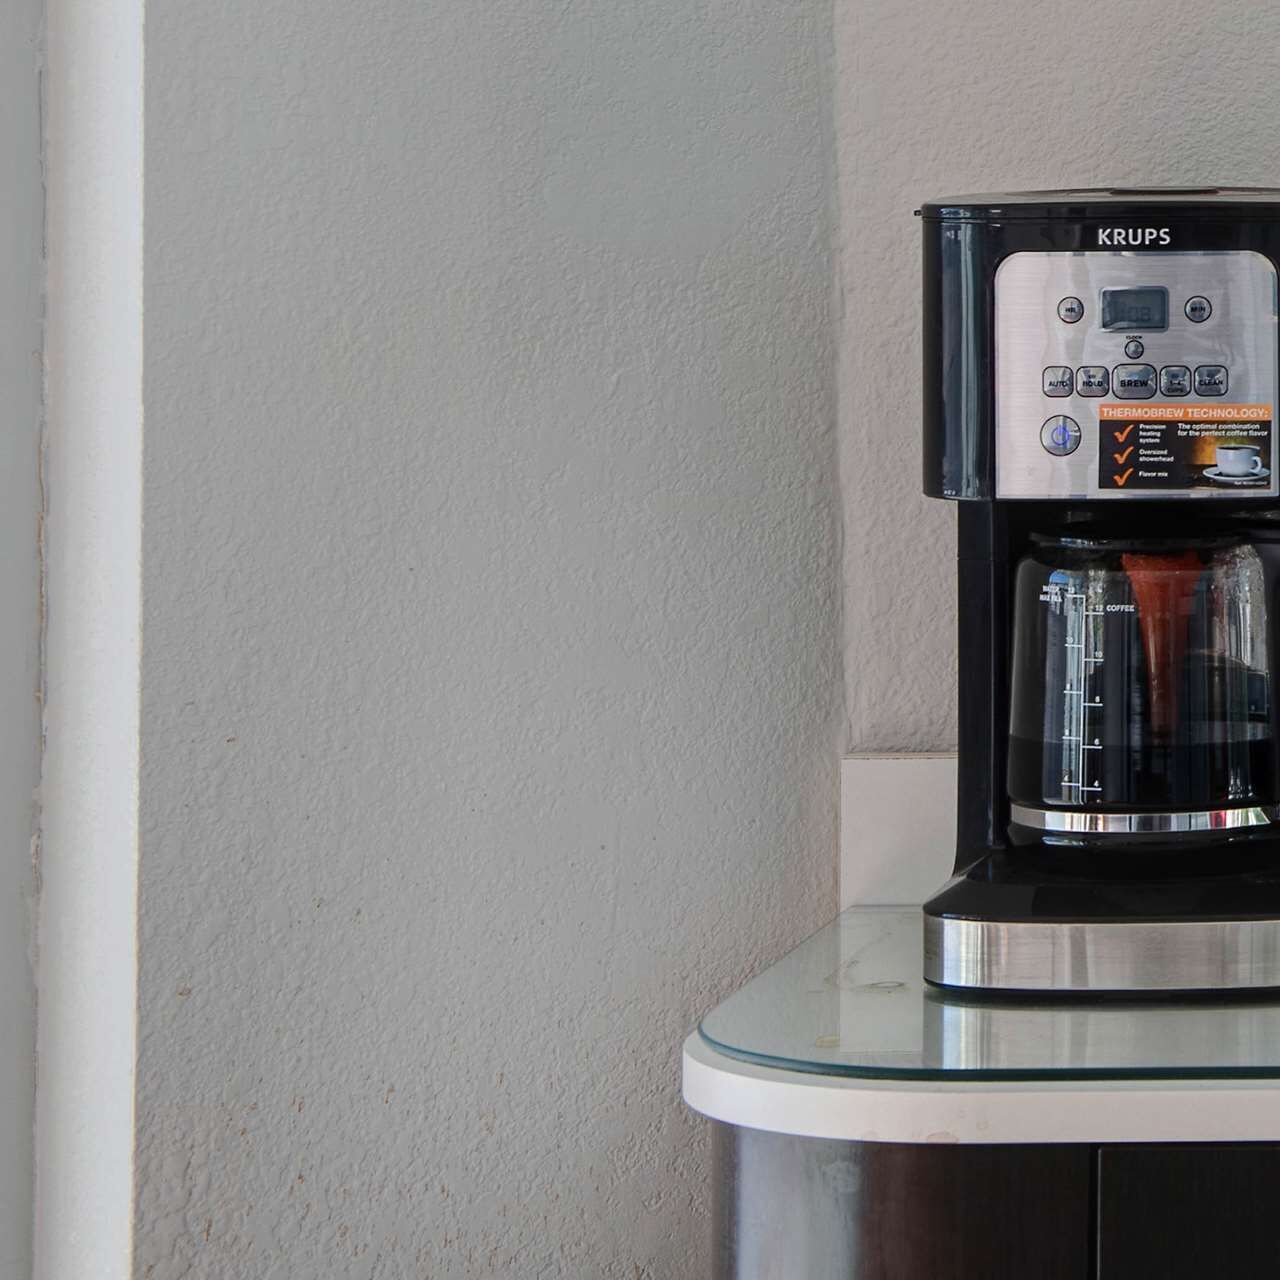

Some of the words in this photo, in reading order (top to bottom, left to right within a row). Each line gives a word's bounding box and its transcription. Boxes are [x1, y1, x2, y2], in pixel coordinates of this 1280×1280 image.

[1098, 228, 1171, 245] KRUPS
[1049, 380, 1068, 388] AUTO
[1082, 380, 1103, 388] HOLD
[1120, 380, 1149, 388] BREW
[1199, 379, 1223, 387] CLEAN
[1102, 407, 1184, 418] THERMOBREW
[1187, 407, 1269, 418] TECHNOLOGY:
[1192, 423, 1217, 431] optimal
[1201, 430, 1225, 438] perfect
[1106, 604, 1136, 612] COFFEE
